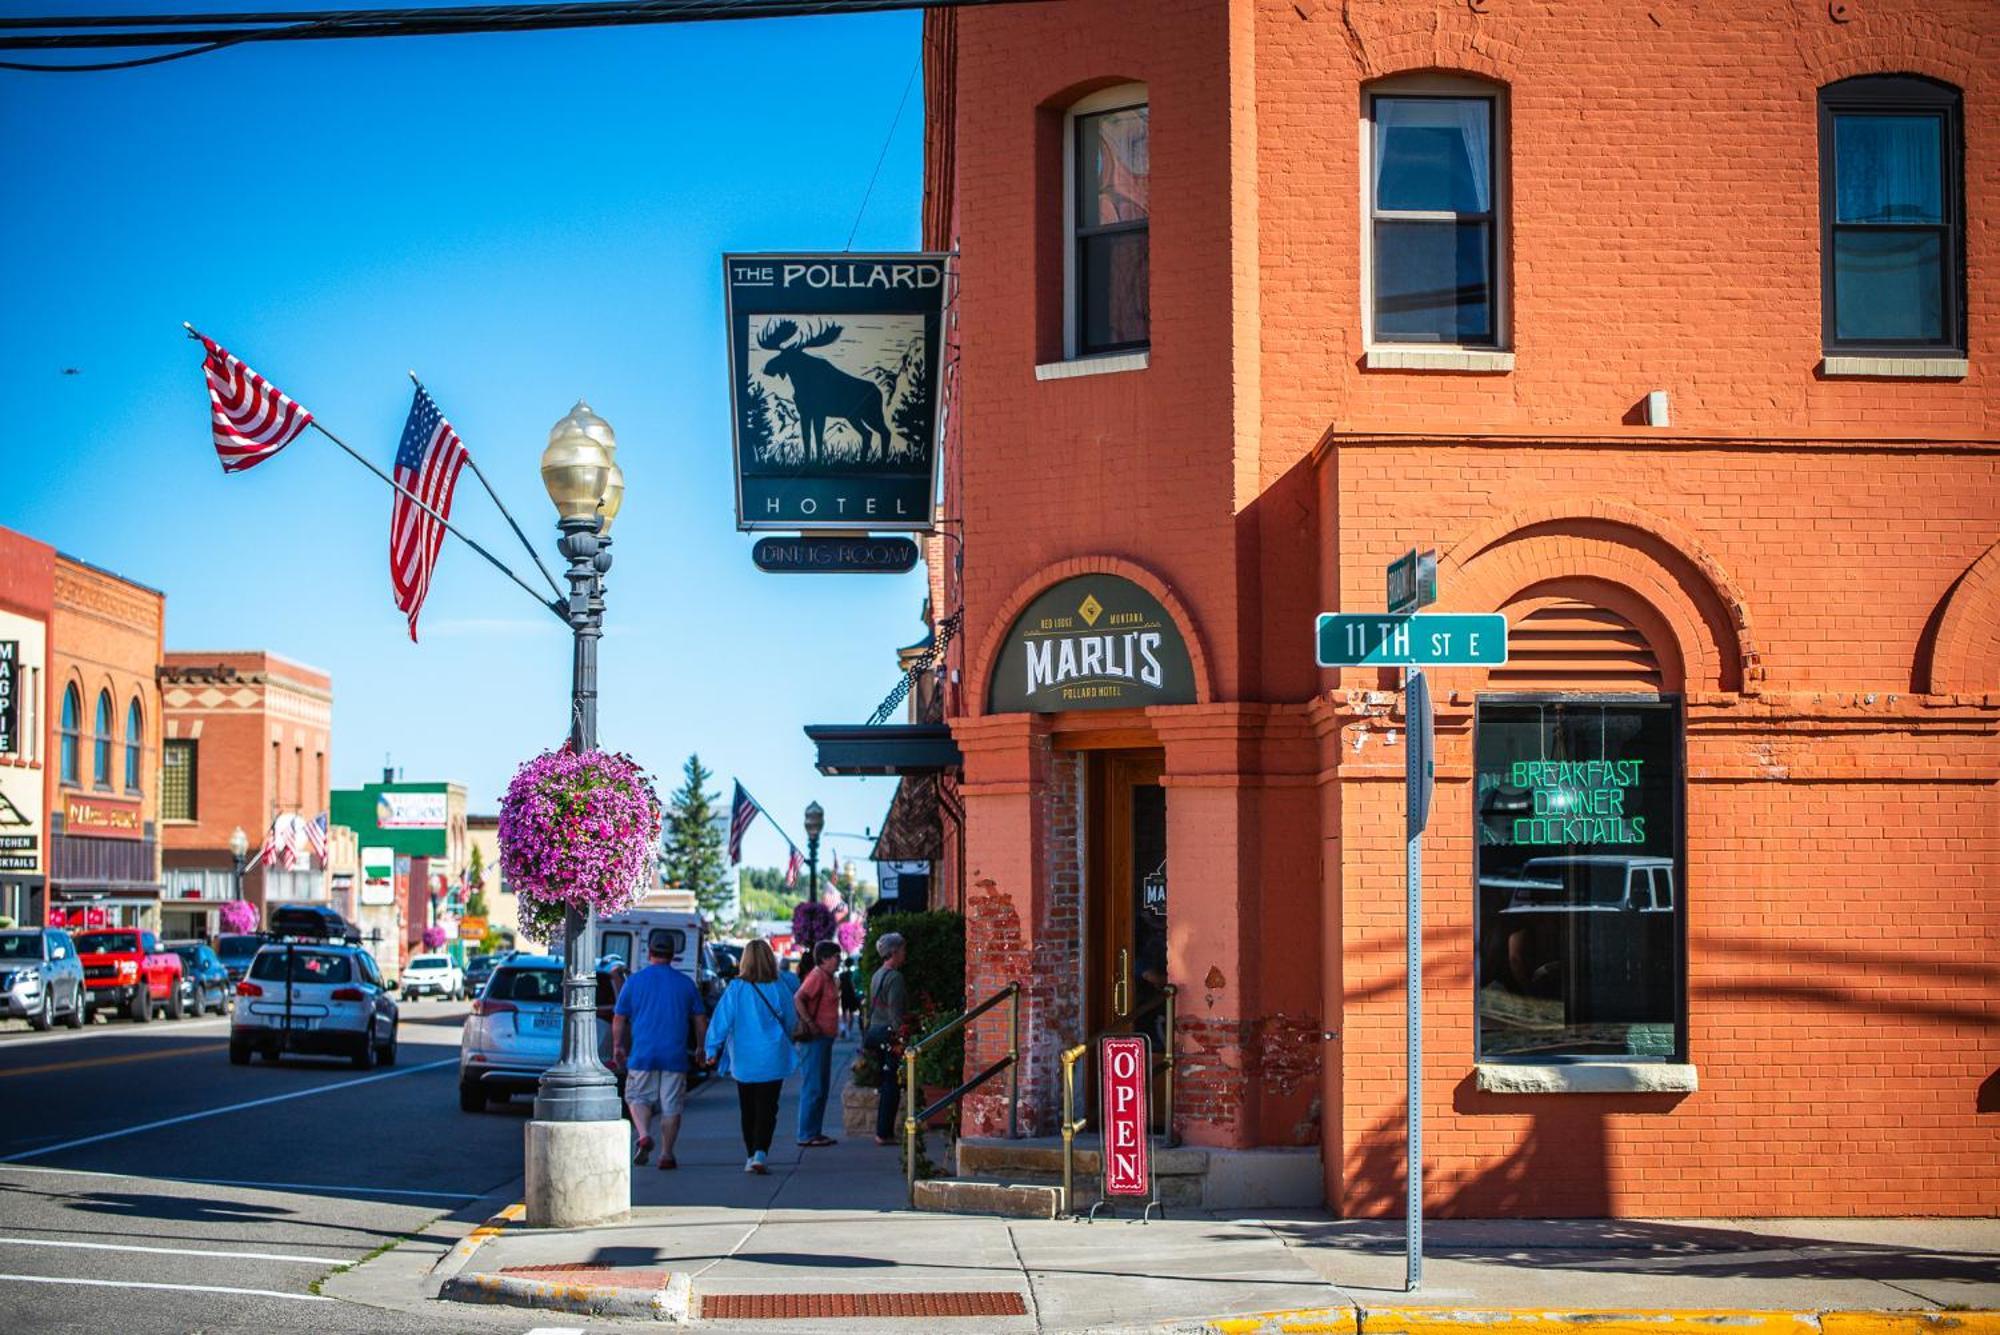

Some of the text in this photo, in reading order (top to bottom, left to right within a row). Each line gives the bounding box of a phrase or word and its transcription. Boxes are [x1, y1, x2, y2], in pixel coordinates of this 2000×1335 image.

[734, 264, 941, 290] THE POLLARD
[767, 498, 907, 514] HOTEL
[839, 545, 910, 563] ROOM
[1109, 612, 1144, 625] MONTANA
[1345, 622, 1480, 657] 11 TH ST E
[1023, 631, 1164, 696] MARLI'S
[0, 642, 13, 752] MAGPIE
[1063, 686, 1122, 700] POLLARD HOTEL
[1512, 760, 1644, 788] BREAKFAST
[1533, 788, 1625, 815] DINNER
[1513, 816, 1646, 845] COCKTAILS
[1113, 1052, 1138, 1181] OPEN
